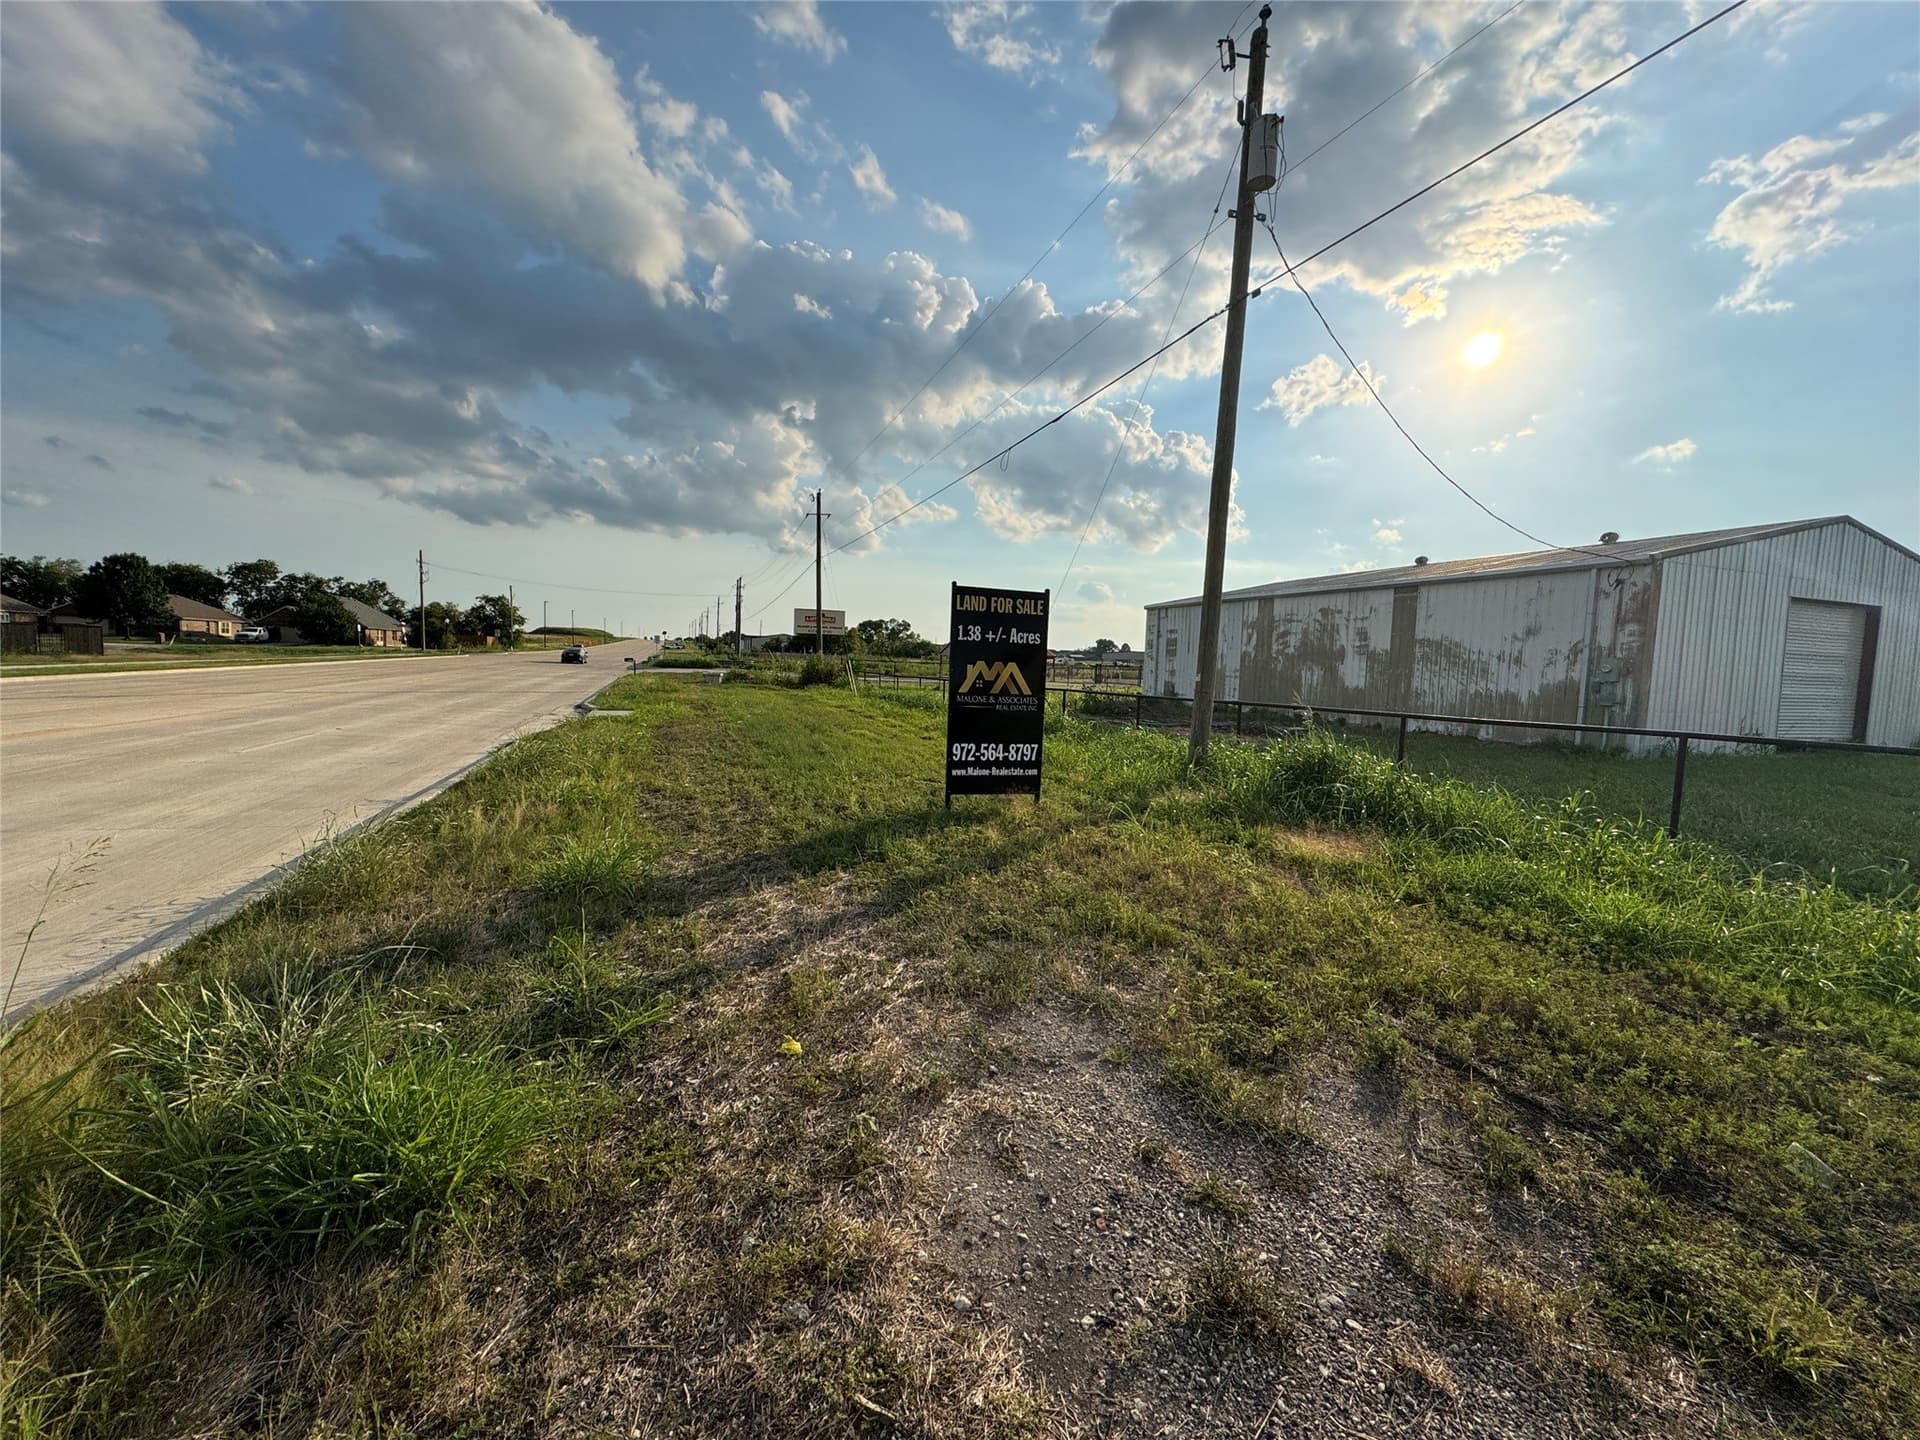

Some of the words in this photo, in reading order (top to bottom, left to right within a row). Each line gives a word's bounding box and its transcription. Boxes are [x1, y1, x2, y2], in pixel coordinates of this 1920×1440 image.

[956, 594, 987, 612] LAND
[991, 597, 1013, 614] FOR
[1016, 599, 1044, 616] SALE
[957, 625, 981, 642] 1.38
[985, 627, 1007, 643] +/-
[1009, 628, 1041, 645] Acres
[956, 695, 988, 704] MALONE
[989, 696, 996, 704] &
[997, 696, 1038, 705] ASSOCIATES
[952, 743, 1038, 761] 972-564-8797
[952, 767, 1038, 776] www.Malone-Realestate.com
